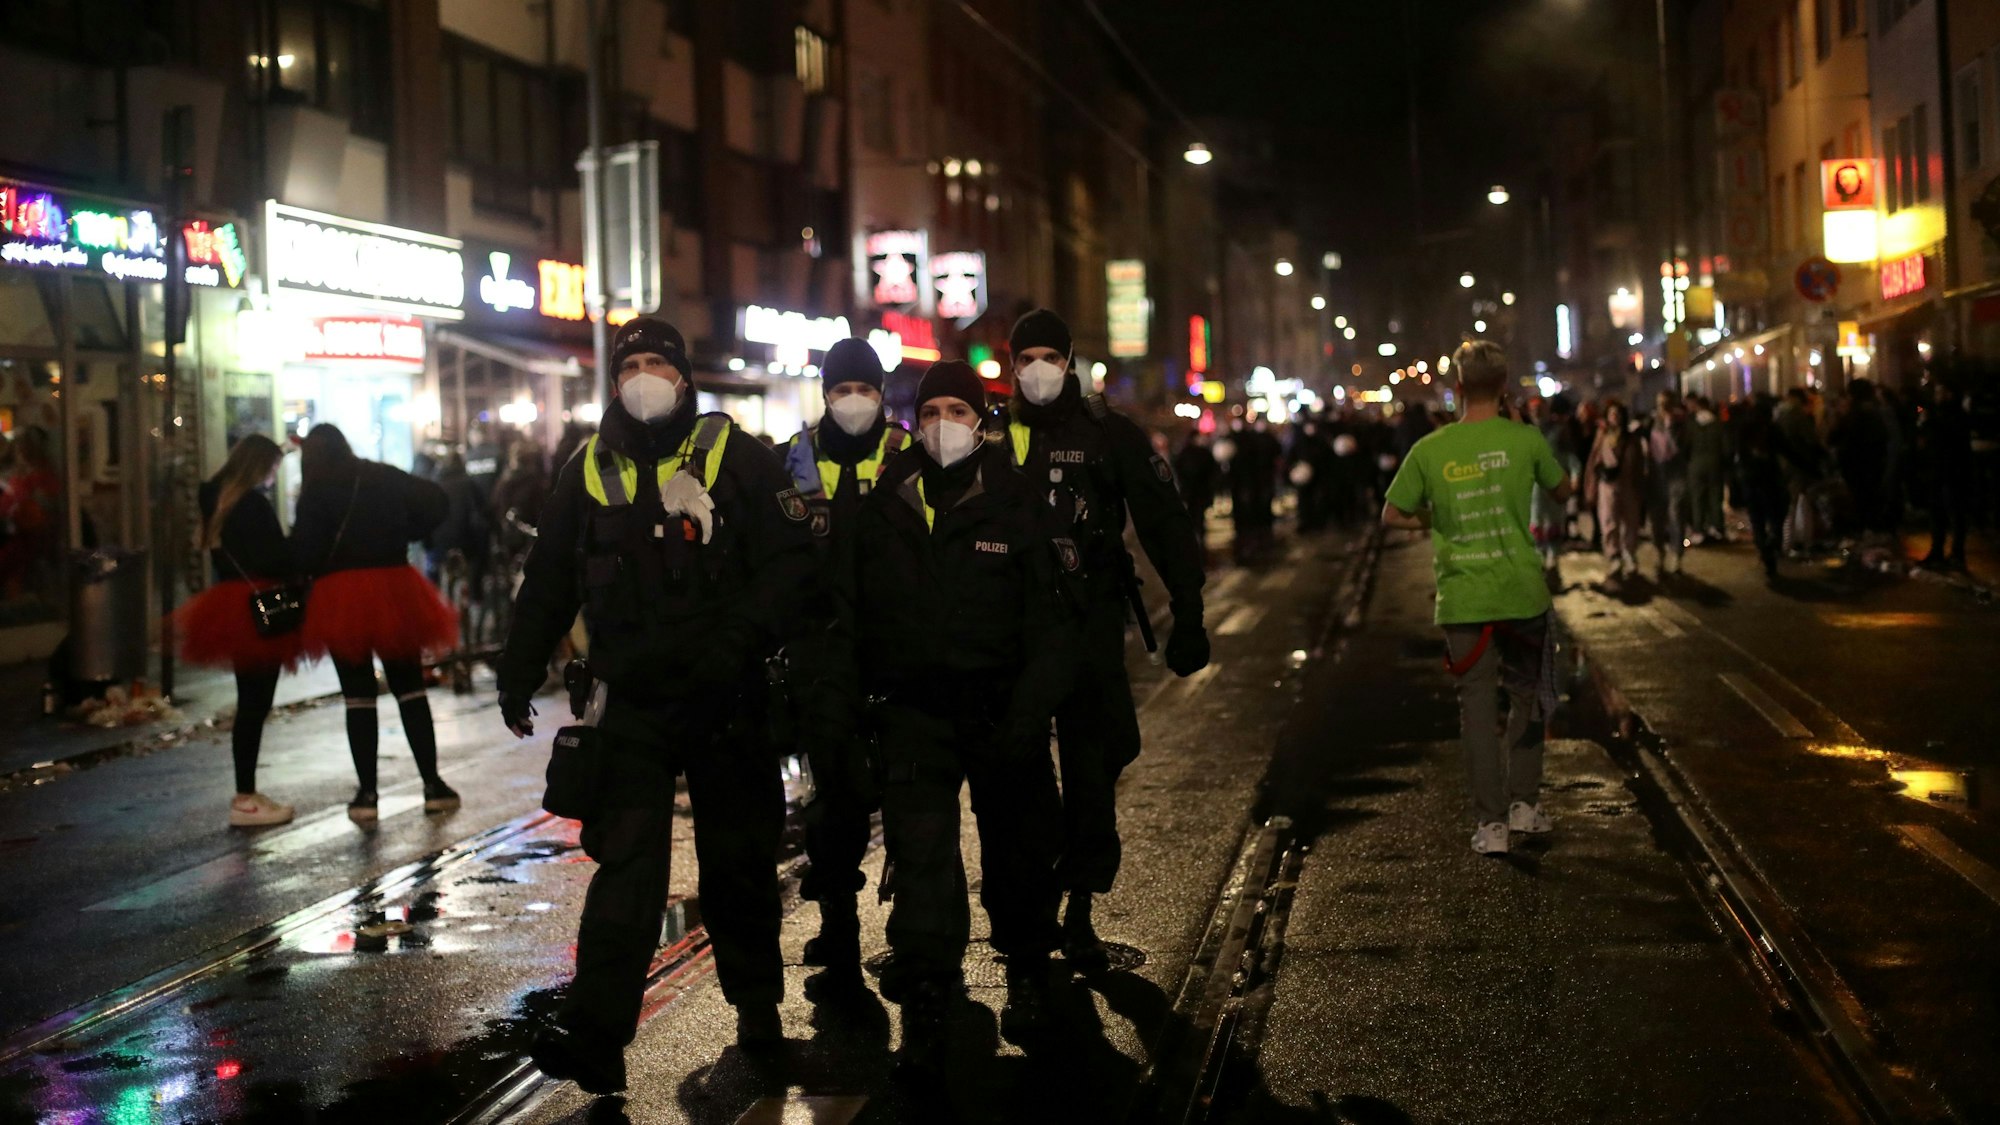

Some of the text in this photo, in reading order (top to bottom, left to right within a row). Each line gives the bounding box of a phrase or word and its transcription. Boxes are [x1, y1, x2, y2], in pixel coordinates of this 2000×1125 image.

[1049, 450, 1085, 464] POLIZEI
[975, 540, 1009, 554] POLIZEI
[557, 736, 580, 747] POLIZEI
